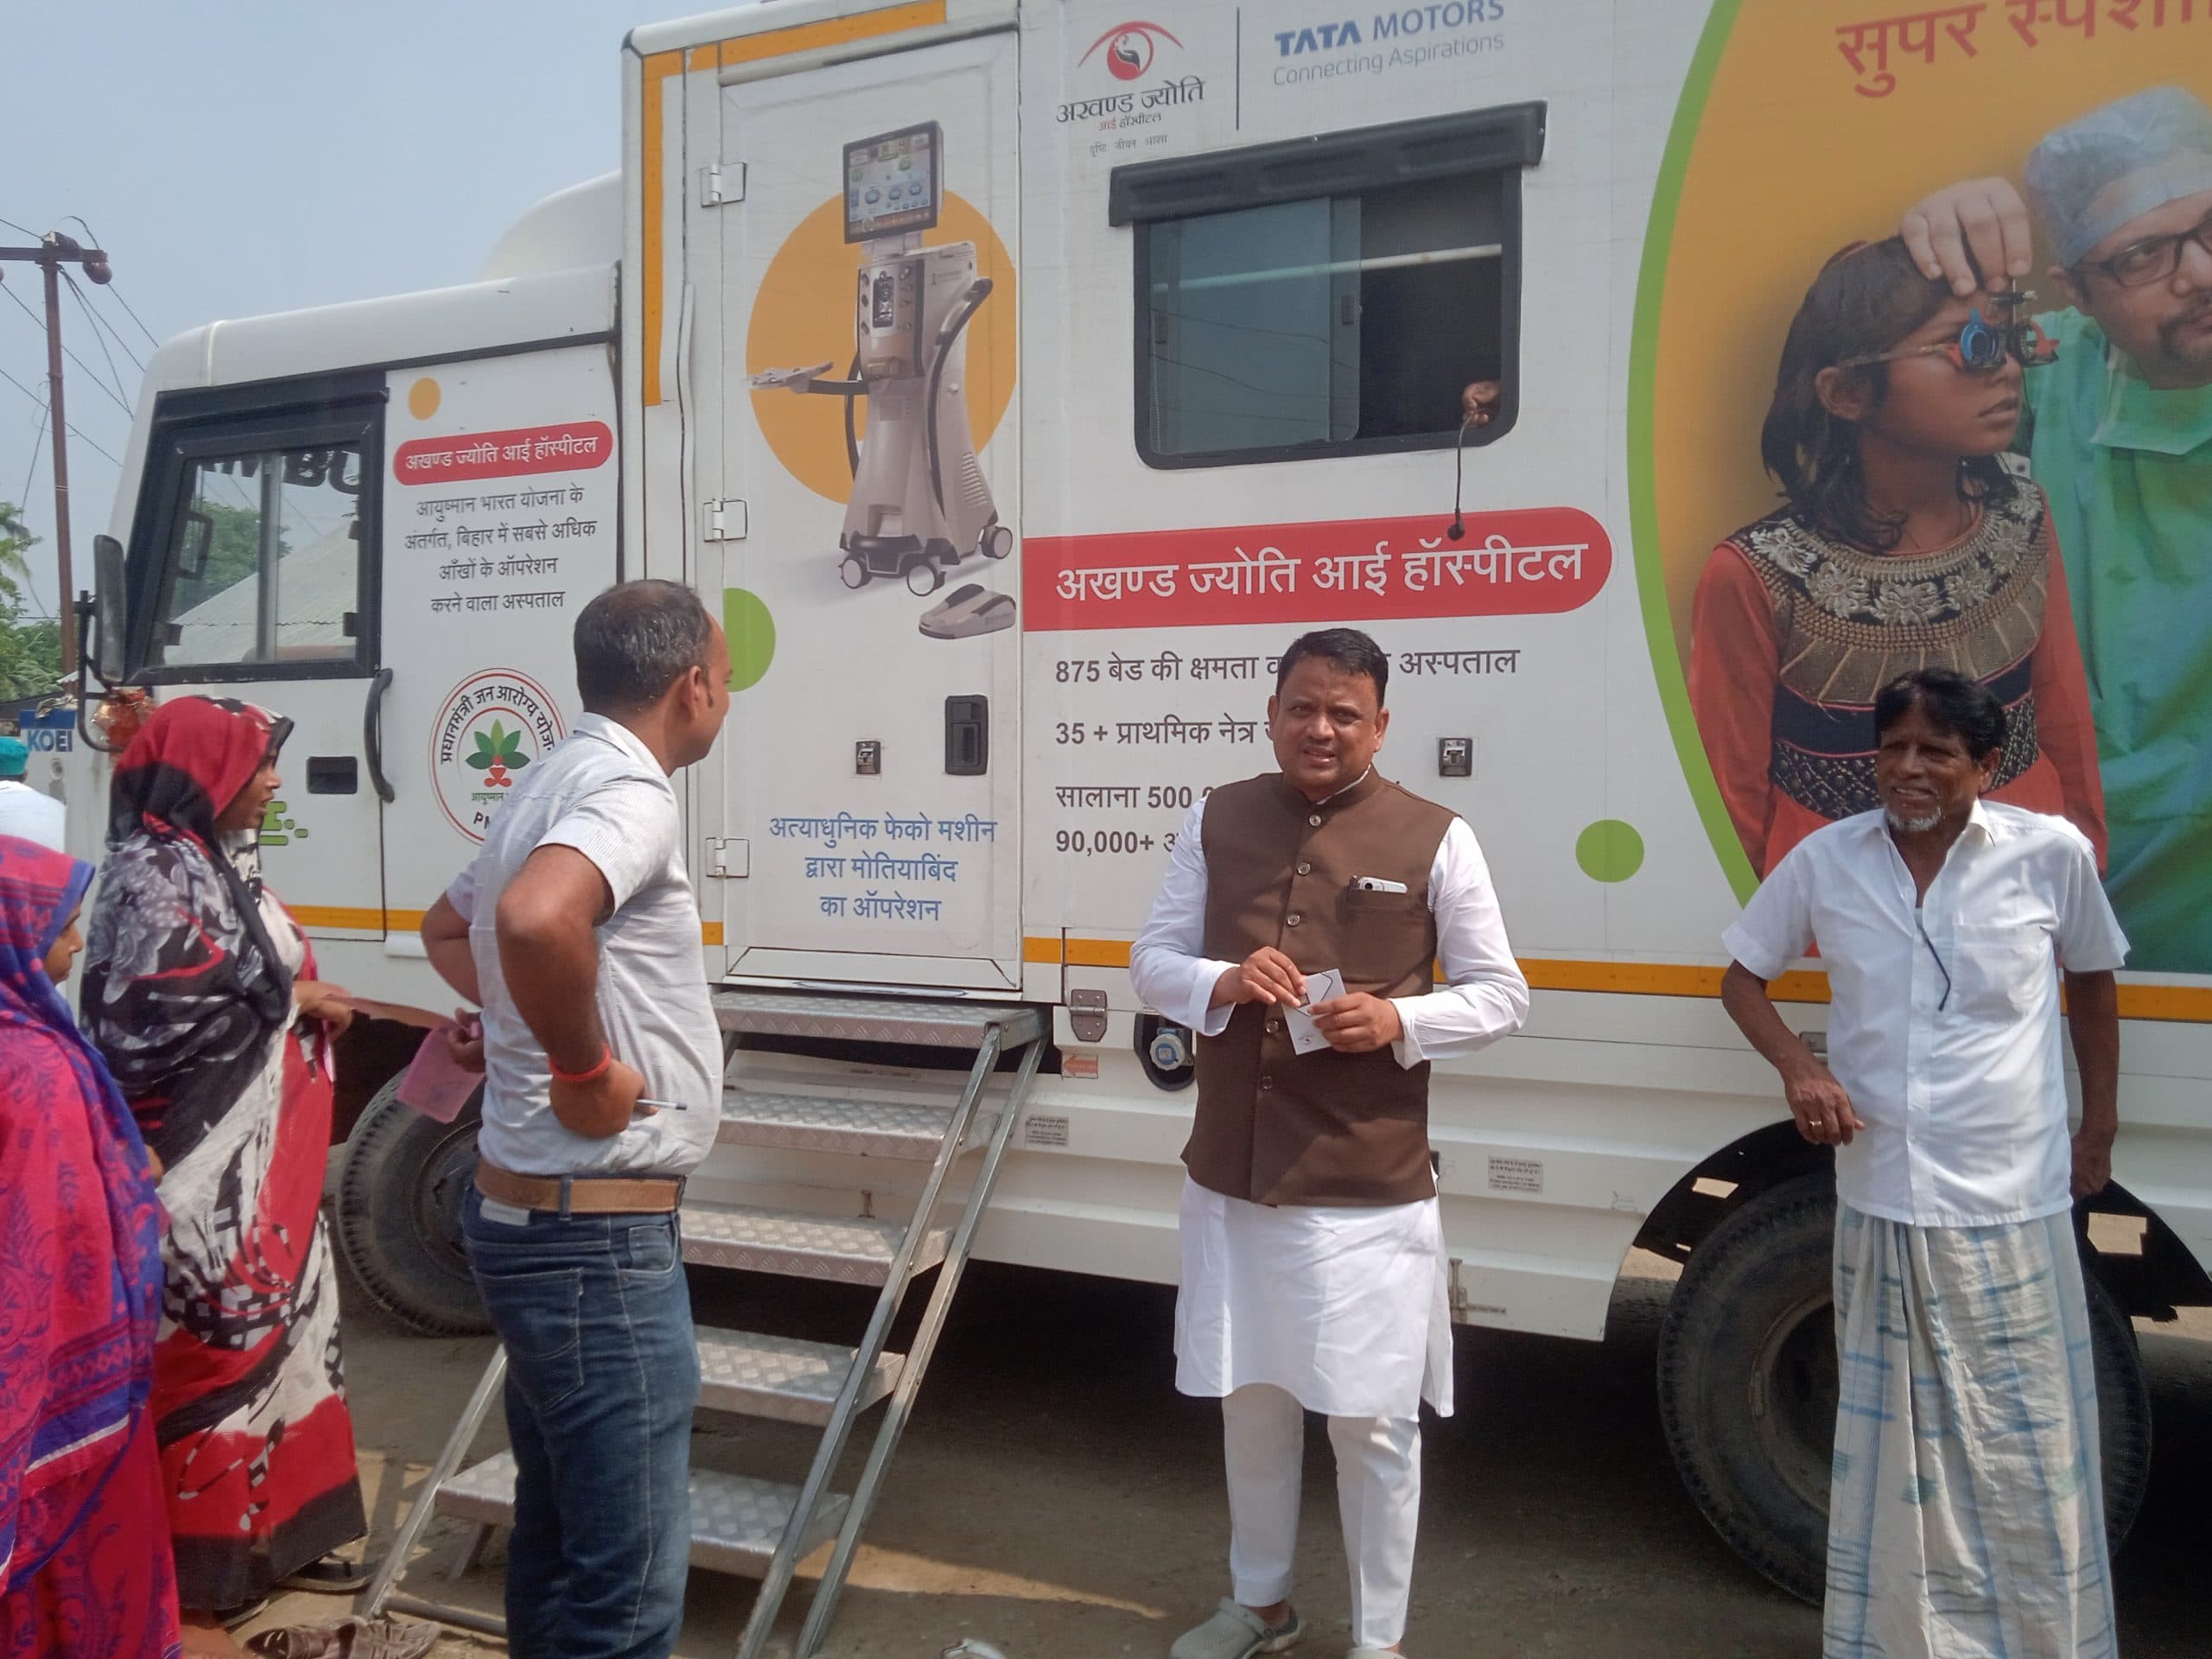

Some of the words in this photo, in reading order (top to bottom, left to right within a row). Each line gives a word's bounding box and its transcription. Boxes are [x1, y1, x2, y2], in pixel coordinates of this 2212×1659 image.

[1274, 22, 1362, 58] TATA
[1373, 0, 1504, 41] MOTORS
[1274, 49, 1382, 86] Connecting
[1389, 31, 1504, 71] Aspirations
[1835, 3, 1986, 98] सुपर
[1057, 93, 1134, 123] अखण्ड
[1141, 75, 1206, 109] ज्योति
[1098, 118, 1116, 131] आई
[405, 451, 453, 470] अखण्ड
[456, 442, 499, 464] ज्योति
[503, 438, 531, 461] आई
[534, 434, 599, 460] हॉस्पीटल
[416, 497, 477, 522] आयुष्मान
[480, 493, 517, 512] भारत
[520, 486, 565, 508] योजना
[569, 482, 585, 503] के
[456, 525, 493, 547] बिहार
[498, 522, 509, 543] में
[512, 519, 549, 542] सबसे
[551, 517, 598, 539] अधिक
[480, 556, 493, 577] के
[497, 553, 559, 576] ऑपरेशन
[1056, 564, 1179, 602] अखण्ड
[1188, 547, 1301, 595] ज्योति
[1312, 541, 1390, 596] आई
[1401, 533, 1589, 591] हॉस्पीटल
[430, 592, 462, 613] करने
[467, 594, 499, 612] वाला
[503, 590, 566, 610] अस्पताल
[1056, 659, 1100, 683] 875
[1108, 652, 1144, 682] बेड
[1151, 652, 1184, 681] की
[1190, 656, 1257, 681] क्षमता
[1399, 648, 1521, 676] अस्पताल
[474, 685, 496, 704] जन
[496, 685, 540, 718] आरोग्य
[537, 711, 556, 751] योज
[1056, 722, 1084, 745] 35
[1093, 725, 1109, 741] +
[1116, 714, 1211, 746] प्राथमिक
[1219, 713, 1257, 743] नेत्र
[1055, 785, 1140, 810] सालाना
[1147, 785, 1213, 809] 500
[769, 811, 879, 849] अत्याधुनिक
[884, 811, 932, 841] फेको
[938, 813, 998, 842] मशीन
[1056, 830, 1155, 858] 90,000+
[804, 856, 846, 879] द्वारा
[851, 850, 958, 882] मोतियाबिंद
[820, 895, 847, 917] का
[853, 890, 942, 921] ऑपरेशन
